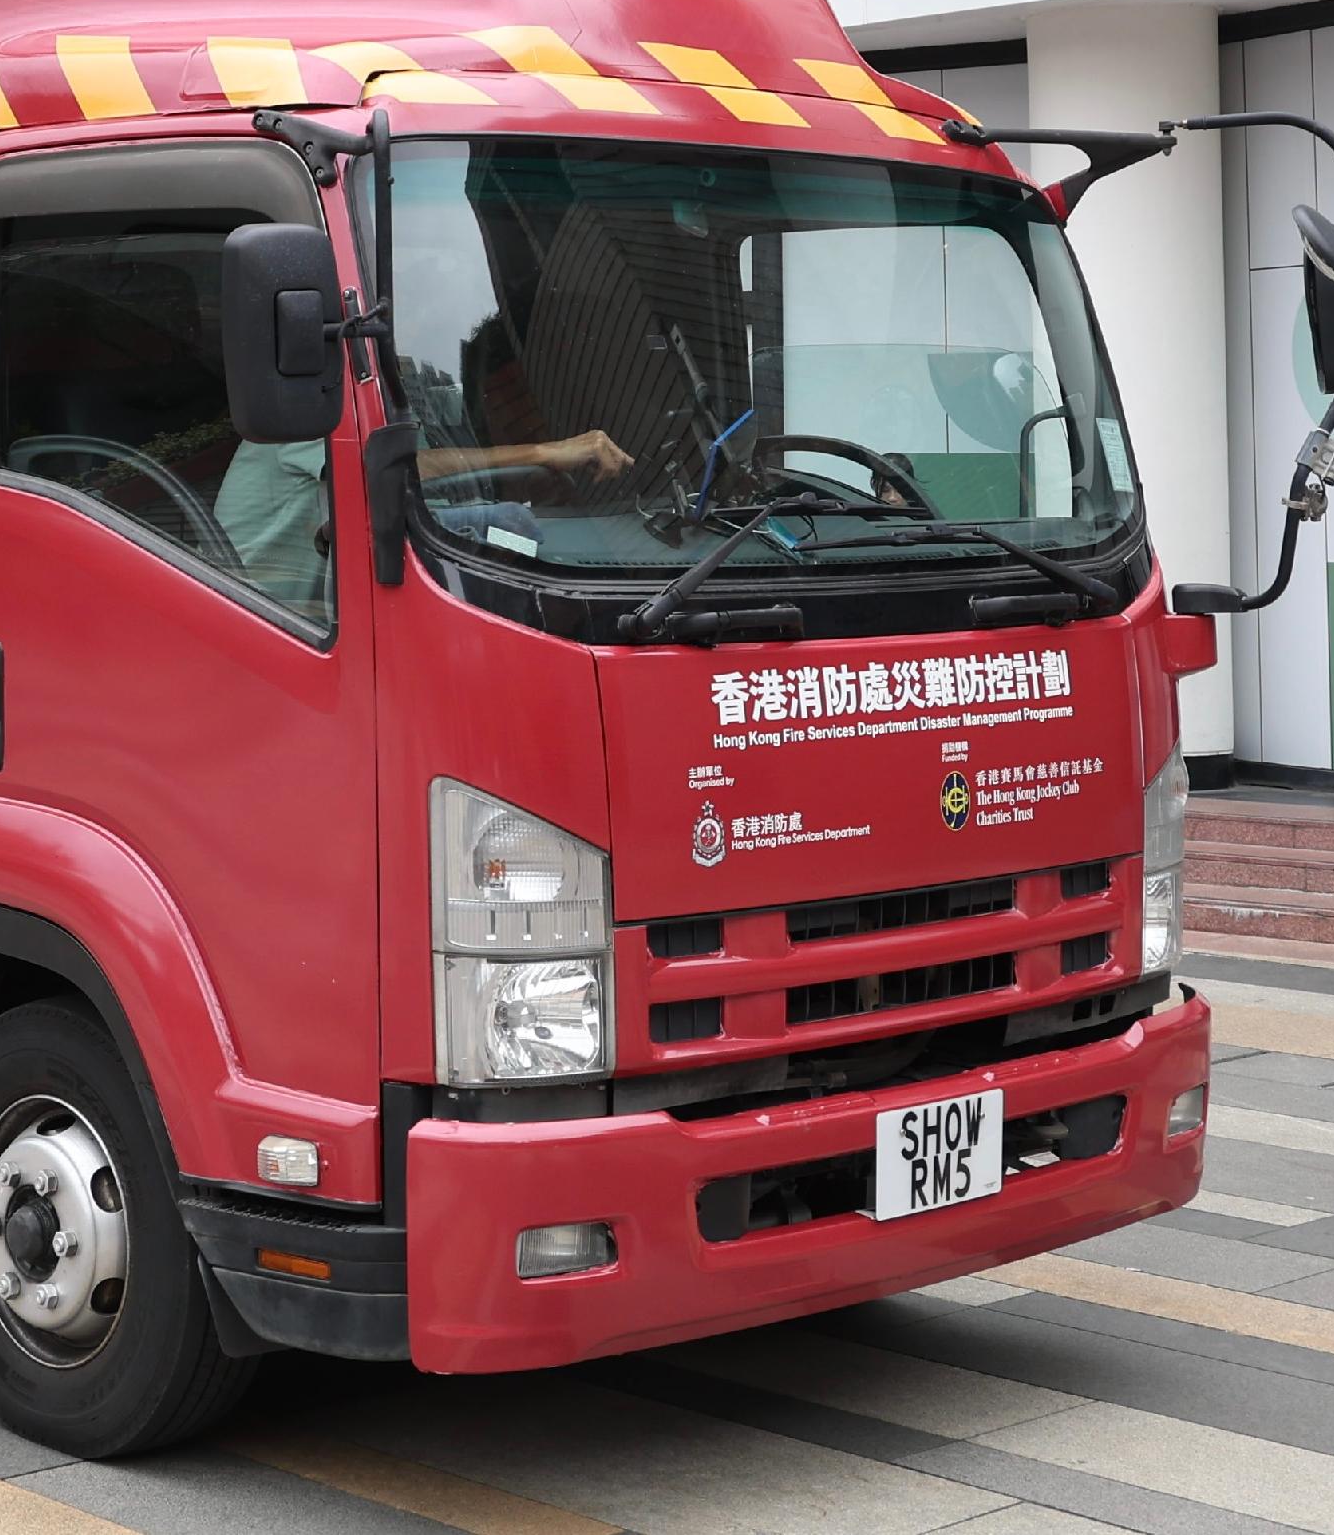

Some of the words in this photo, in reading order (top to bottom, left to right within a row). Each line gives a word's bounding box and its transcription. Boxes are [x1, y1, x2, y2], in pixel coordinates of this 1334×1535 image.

[710, 649, 1071, 726] 香港消防處災難防控計劃
[713, 732, 746, 751] Hong
[749, 730, 781, 748] Kong
[784, 728, 805, 743] Fire
[808, 725, 856, 741] Services
[858, 719, 918, 737] Department
[920, 715, 961, 732] Disaster
[963, 709, 1021, 729] Management
[1024, 705, 1073, 723] Programme
[689, 777, 725, 791] Organised
[725, 776, 735, 787] by
[975, 757, 1104, 787] 香港賽馬會慈善信託基金
[976, 791, 992, 806] The
[993, 789, 1015, 806] Hong
[1016, 786, 1036, 803] Kong
[1036, 782, 1062, 803] Jockey
[1062, 779, 1080, 795] Club
[731, 811, 803, 838] 香港消防處
[976, 810, 1012, 826] Charities
[1013, 807, 1034, 822] Trust
[731, 839, 754, 851] Hong
[755, 837, 777, 849] Kong
[777, 835, 792, 845] Fire
[792, 832, 824, 844] Services
[824, 825, 871, 841] Department
[901, 1097, 982, 1161] SHOW
[910, 1148, 972, 1210] RM5
